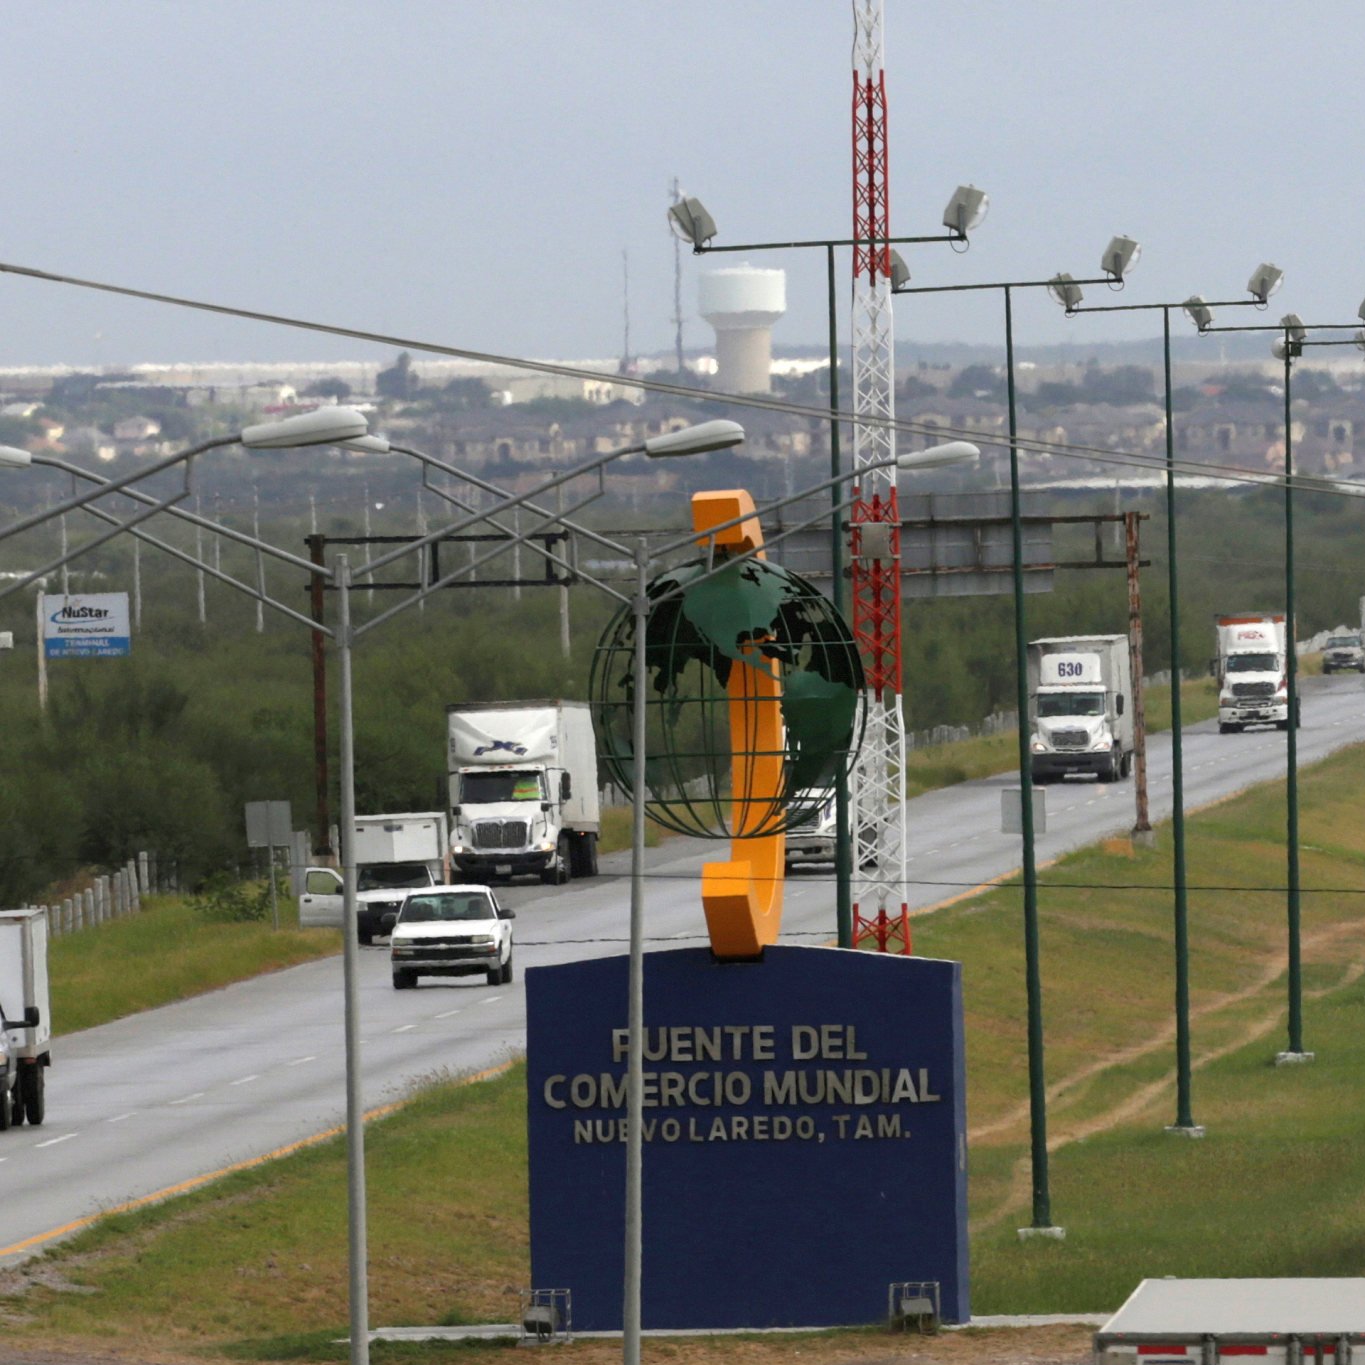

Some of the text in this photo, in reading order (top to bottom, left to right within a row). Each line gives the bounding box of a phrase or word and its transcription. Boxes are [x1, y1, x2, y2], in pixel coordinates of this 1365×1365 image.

[62, 606, 109, 619] NuStar
[1057, 662, 1083, 677] 630
[792, 1024, 868, 1061] DEL
[543, 1067, 941, 1109] COMERCIO MUNDIAL
[574, 1113, 912, 1145] NUEVO LAREDO, TAM.
